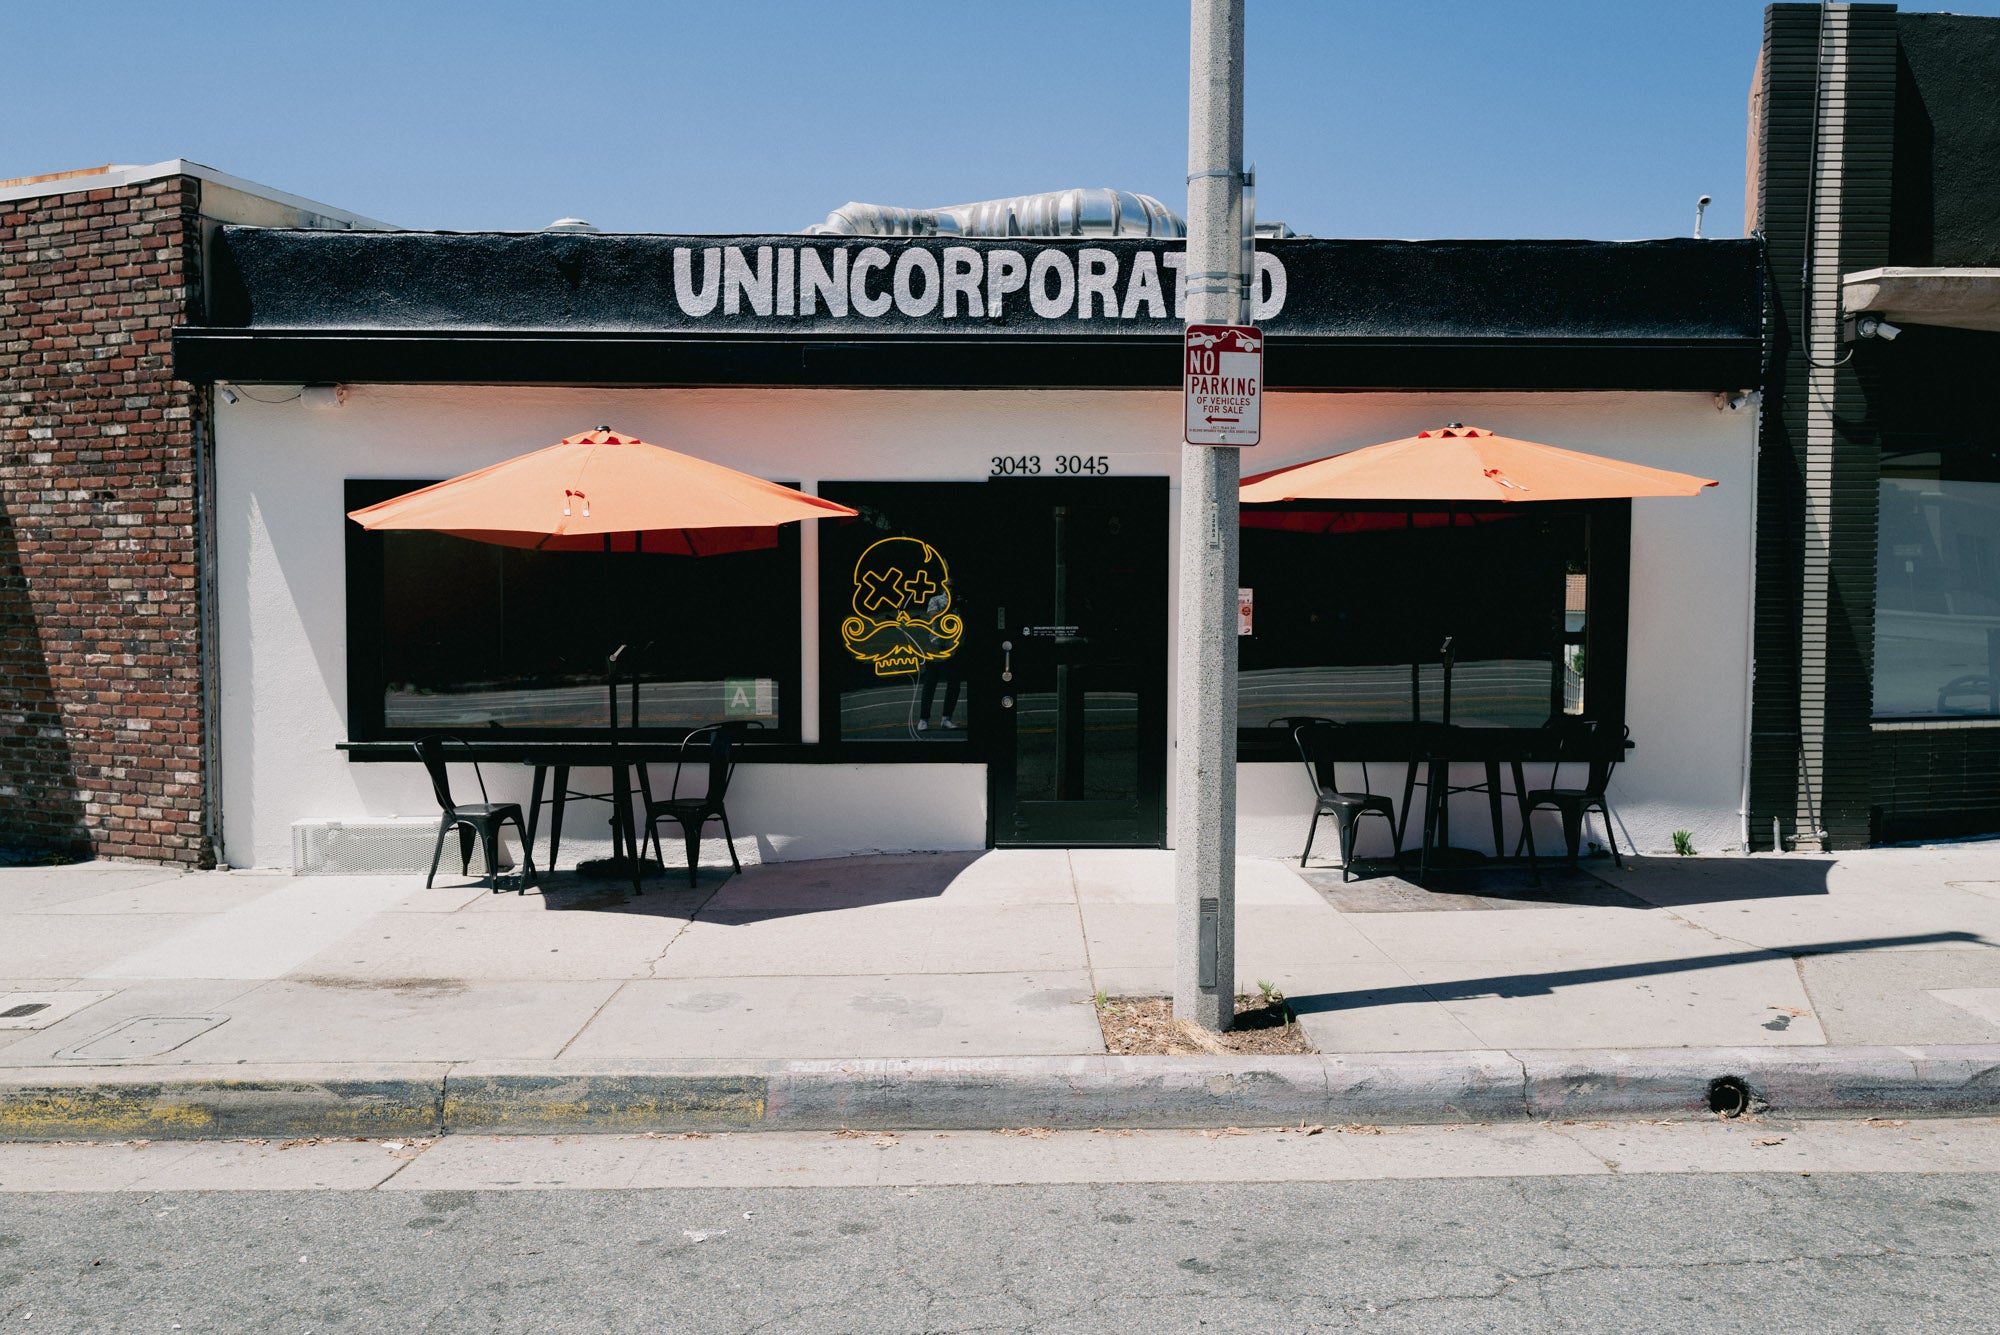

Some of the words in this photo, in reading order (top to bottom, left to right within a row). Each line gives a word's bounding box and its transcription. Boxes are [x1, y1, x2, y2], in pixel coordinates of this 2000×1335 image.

[673, 246, 1288, 320] UNINCORPORATD
[1189, 350, 1215, 375] NO
[1191, 376, 1256, 397] PARKING
[1196, 396, 1208, 405] OF
[1210, 397, 1251, 406] VEHICLES
[1202, 405, 1220, 414] FOR
[1222, 406, 1244, 414] SALE
[990, 455, 1042, 476] 3043
[1055, 455, 1110, 475] 3045
[730, 686, 751, 708] A
